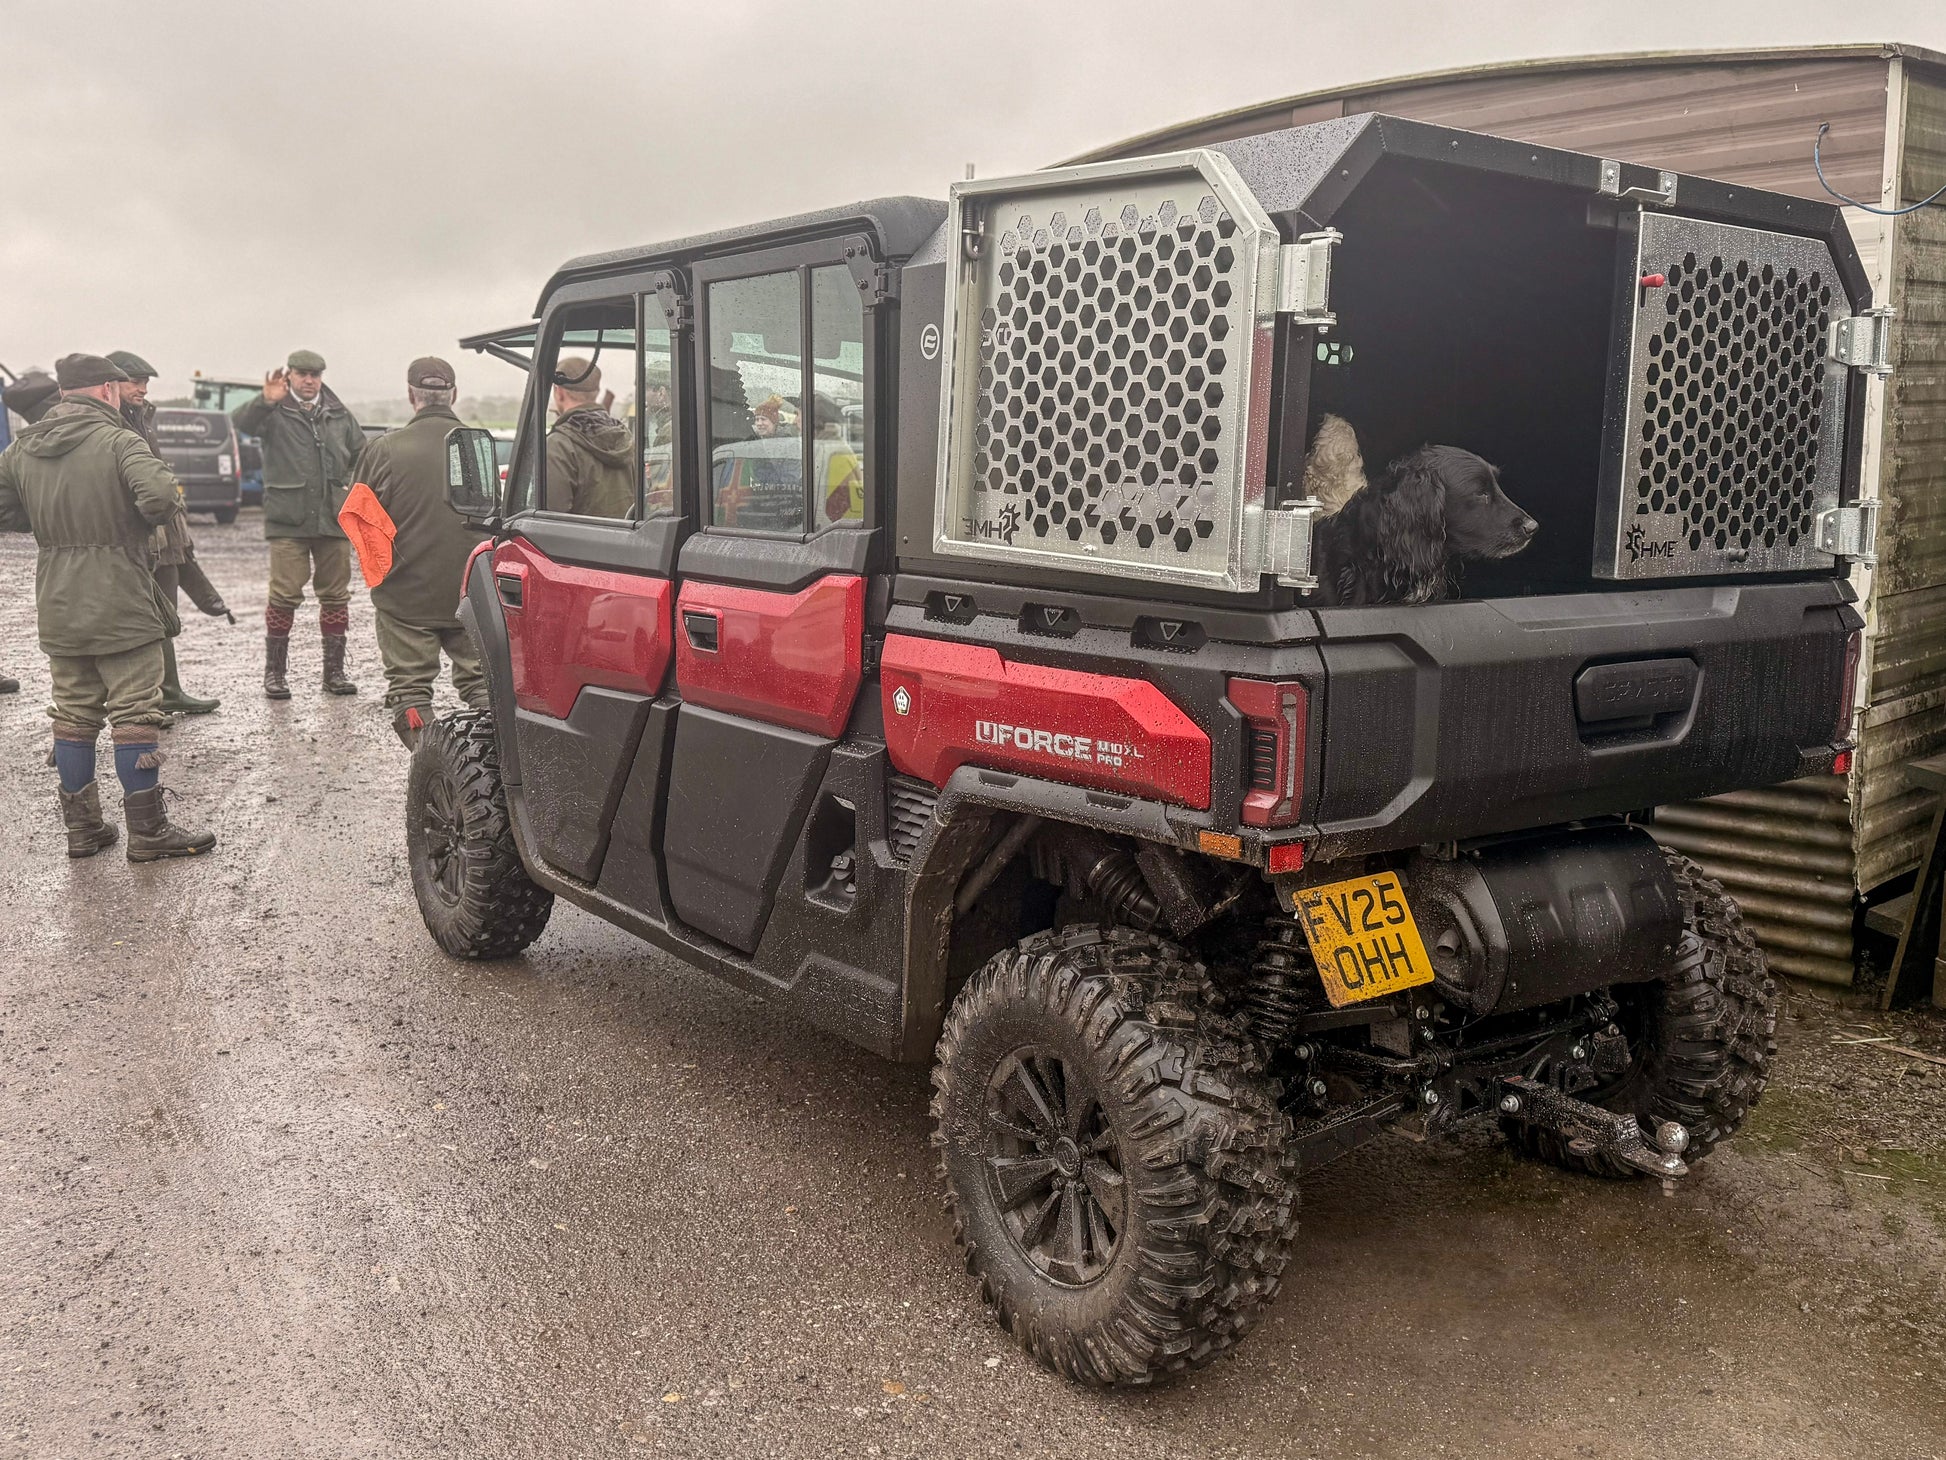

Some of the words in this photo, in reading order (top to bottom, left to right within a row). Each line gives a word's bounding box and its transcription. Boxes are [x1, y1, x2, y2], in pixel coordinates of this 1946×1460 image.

[1640, 540, 1679, 558] HME
[975, 720, 1092, 762] UFORCE
[1096, 753, 1123, 767] PRO
[1301, 883, 1406, 944] FV25
[1332, 932, 1415, 990] OHH
